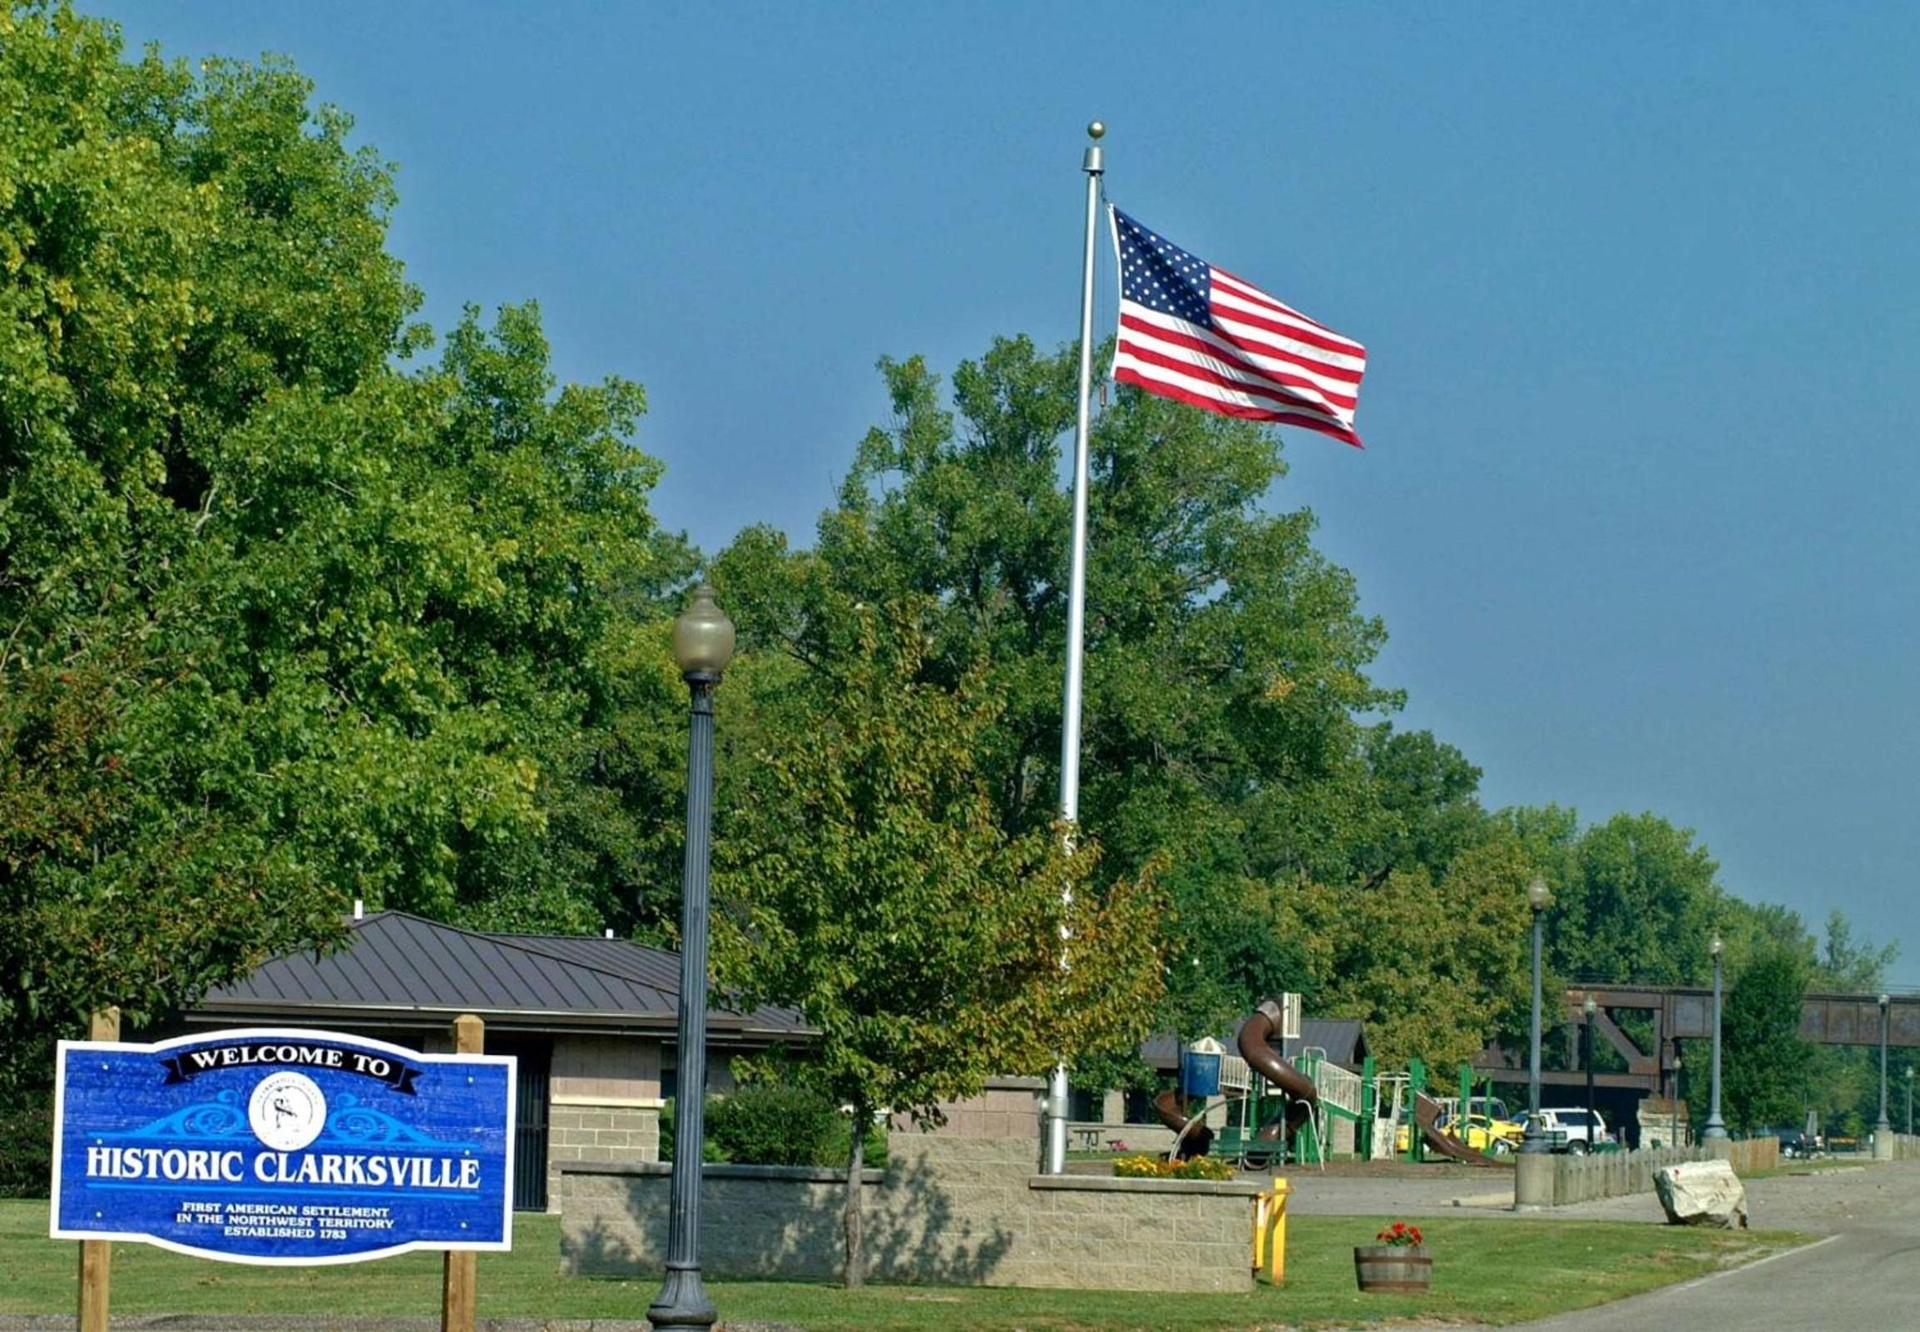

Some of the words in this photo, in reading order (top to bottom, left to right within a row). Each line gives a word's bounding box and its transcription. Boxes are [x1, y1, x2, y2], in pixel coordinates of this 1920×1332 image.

[190, 1045, 344, 1069] WELCOME
[352, 1055, 391, 1077] TO
[86, 1147, 243, 1181] HISTORIC
[254, 1152, 480, 1189] CLARKSVILLE
[183, 1202, 221, 1213] FIRST
[225, 1203, 297, 1215] AMERICAN
[302, 1206, 390, 1218] SETTLEMENT
[176, 1213, 192, 1223] IN
[197, 1213, 223, 1224] THE
[229, 1214, 313, 1227] NORTHWEST
[318, 1217, 394, 1229] TERRITORY
[224, 1226, 315, 1239] ESTABLISHED
[320, 1229, 347, 1239] 1783
